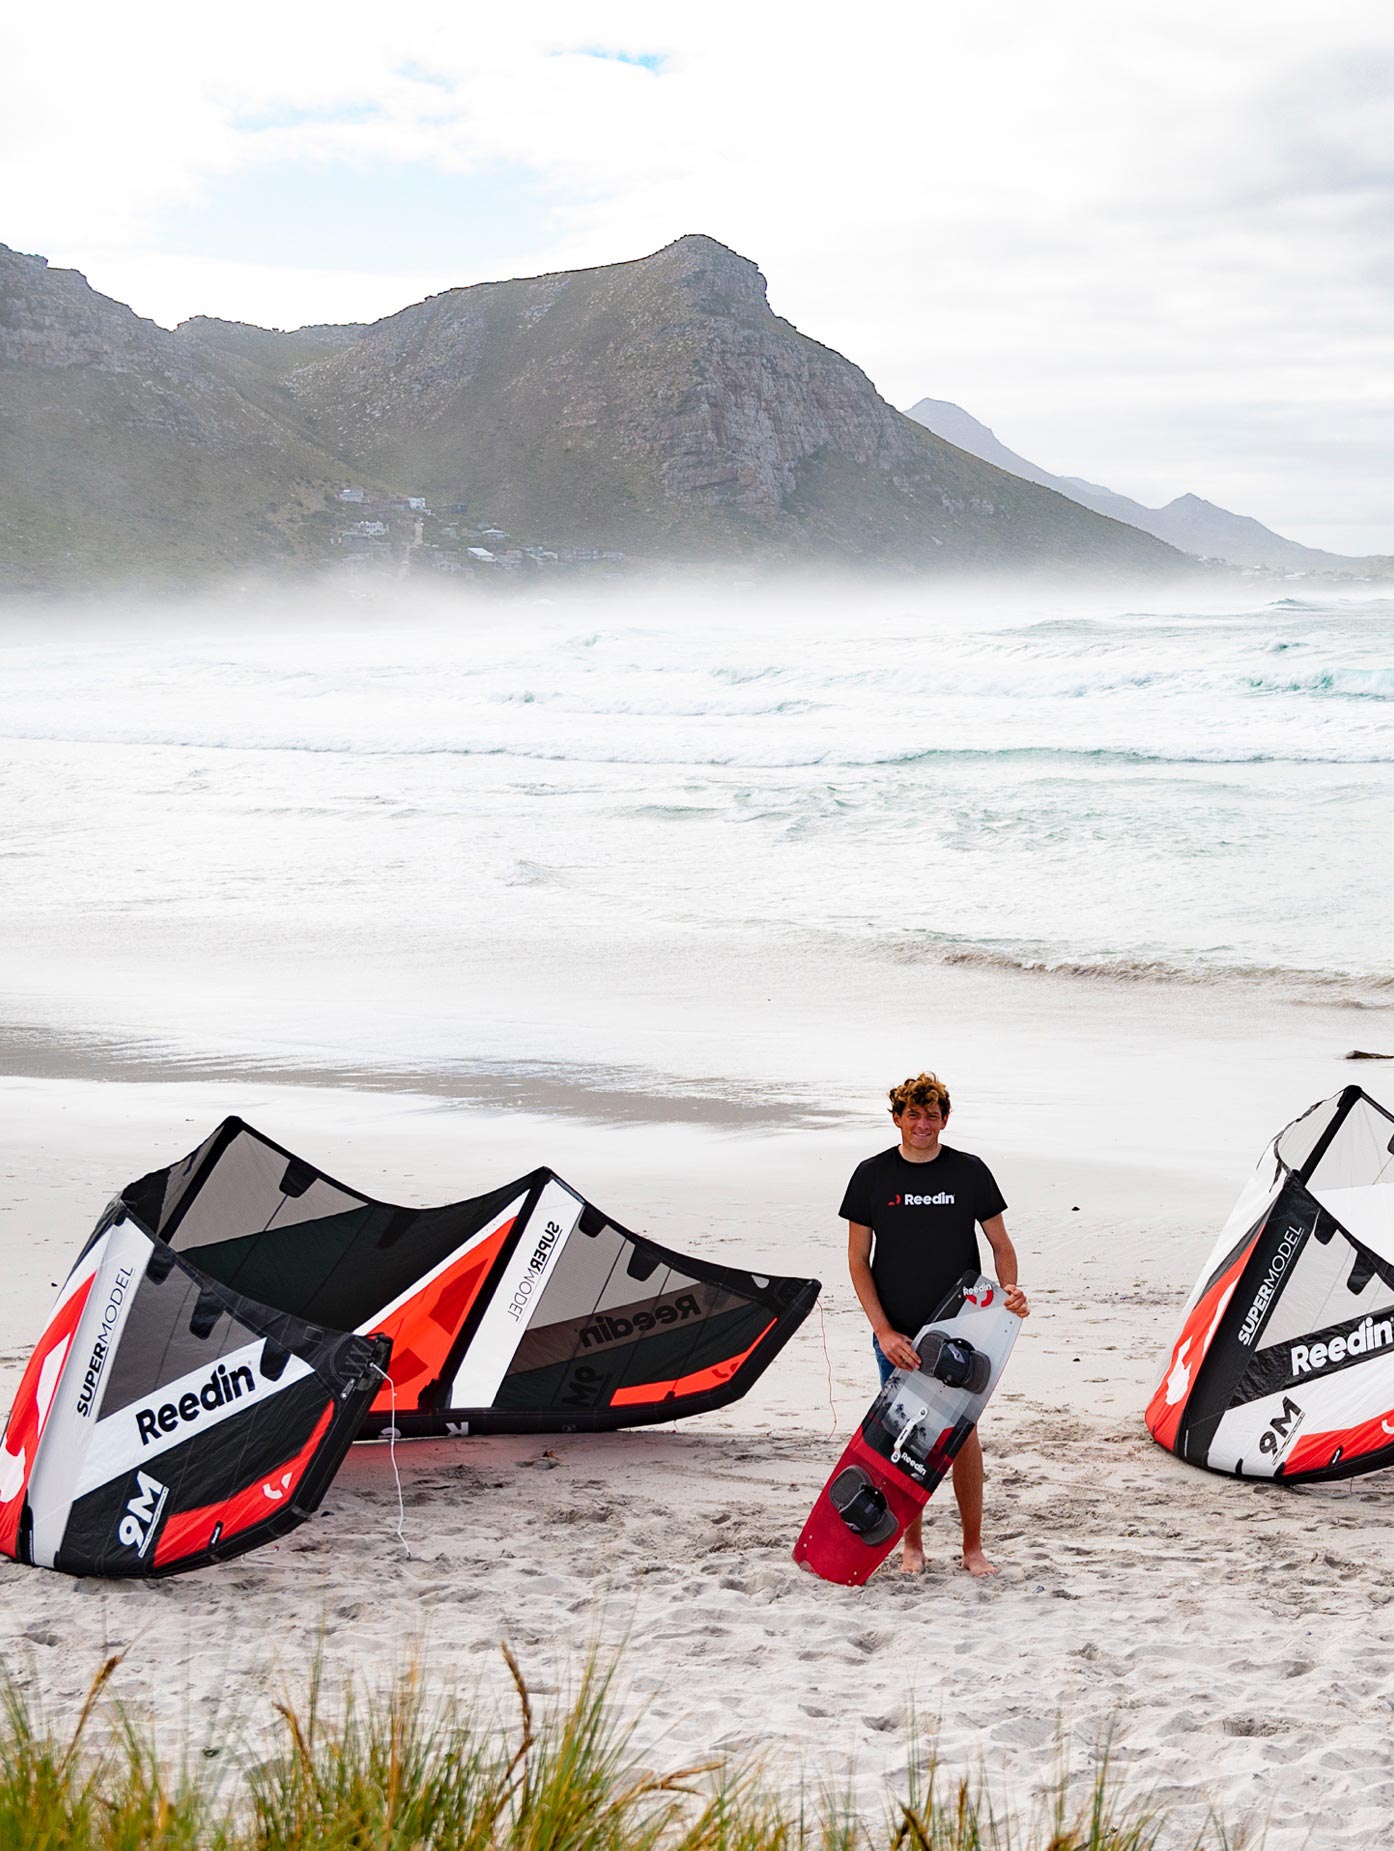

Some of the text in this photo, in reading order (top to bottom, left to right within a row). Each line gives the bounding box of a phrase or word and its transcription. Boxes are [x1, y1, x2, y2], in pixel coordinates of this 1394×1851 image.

[904, 1192, 955, 1206] Reedin
[962, 1283, 993, 1297] Reedin
[1238, 1225, 1303, 1345] SUPERMODEL
[77, 1267, 133, 1417] SUPERMODEL
[1291, 1316, 1393, 1376] Reedin
[136, 1364, 256, 1446] Reedin
[1259, 1396, 1301, 1456] 9M
[901, 1452, 927, 1476] Reedin
[119, 1471, 163, 1548] 9M
